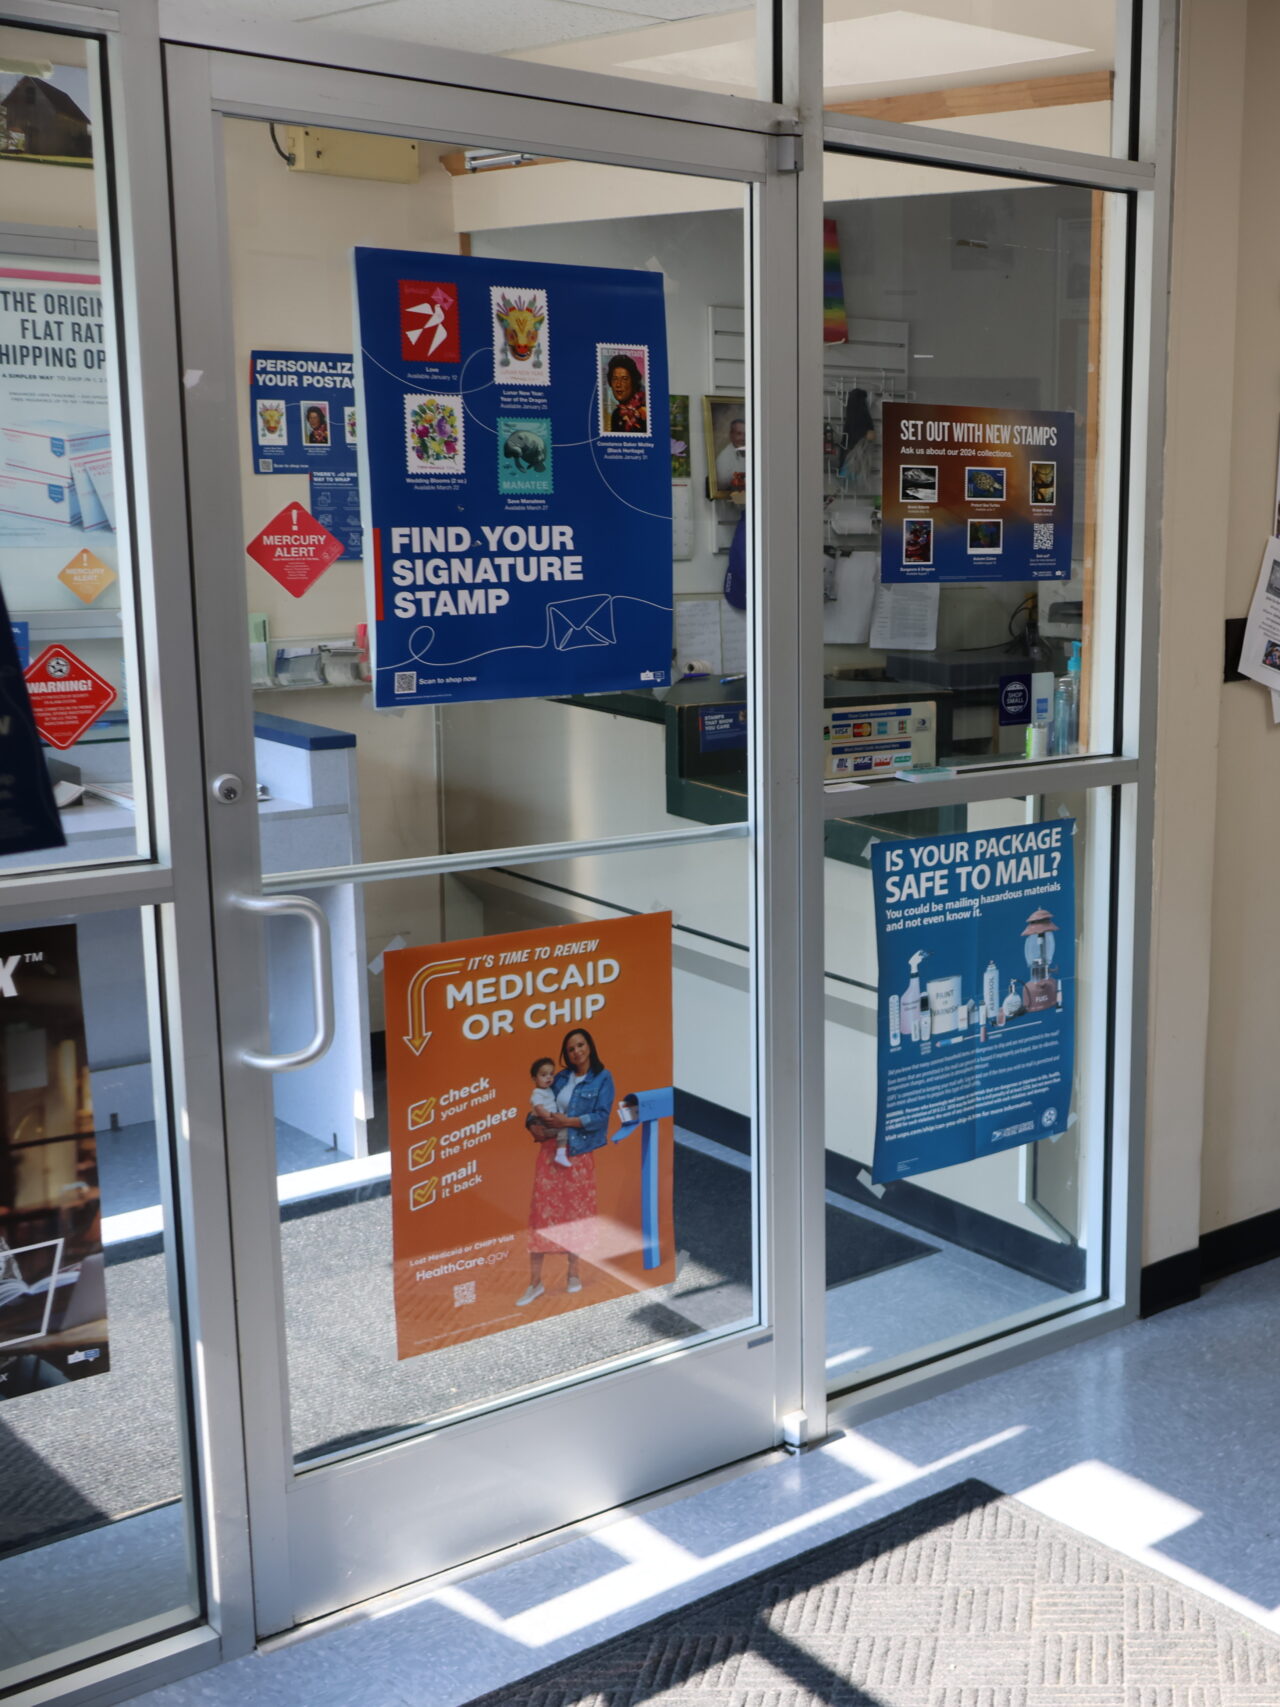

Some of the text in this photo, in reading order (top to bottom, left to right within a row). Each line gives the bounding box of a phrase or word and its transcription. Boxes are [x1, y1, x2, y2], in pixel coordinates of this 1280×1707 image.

[0, 290, 37, 314] THE
[21, 319, 104, 344] FLAT RAT
[0, 344, 106, 370] HIPPING OP
[256, 374, 355, 389] YOUR POSTA
[900, 420, 1058, 446] SET OUT WITH NEW STAMPS
[926, 447, 946, 456] about
[503, 480, 549, 489] MANATEE
[262, 534, 327, 545] MERCURY
[274, 546, 316, 557] ALERT
[391, 525, 574, 554] FIND YOUR
[72, 574, 98, 582] ALERT
[392, 555, 584, 586] SIGNATURE
[394, 588, 510, 618] STAMP
[26, 680, 93, 693] WARNING!
[419, 675, 477, 686] Scan to shop now
[885, 827, 1062, 872] IS YOUR PACKAGE
[885, 852, 1062, 904] SAFE TO MAIL?
[886, 881, 1061, 920] You could be mailing hazardous materials
[886, 907, 983, 932] and not even know it.
[467, 938, 600, 971] IT'S TIME TO RENEW
[446, 958, 621, 1010] MEDICAID
[936, 988, 955, 999] PAINT
[462, 993, 606, 1040] OR CHIP
[439, 1077, 490, 1106] check
[441, 1089, 496, 1121] your mail
[440, 1106, 518, 1146] complete
[440, 1131, 492, 1159] the form
[441, 1160, 477, 1186] mail
[442, 1175, 482, 1198] it back
[409, 1257, 426, 1267] Lost
[428, 1245, 463, 1263] Medicaid
[464, 1244, 473, 1253] or
[498, 1234, 515, 1245] Visit
[416, 1250, 509, 1282] HealthCare.gov
